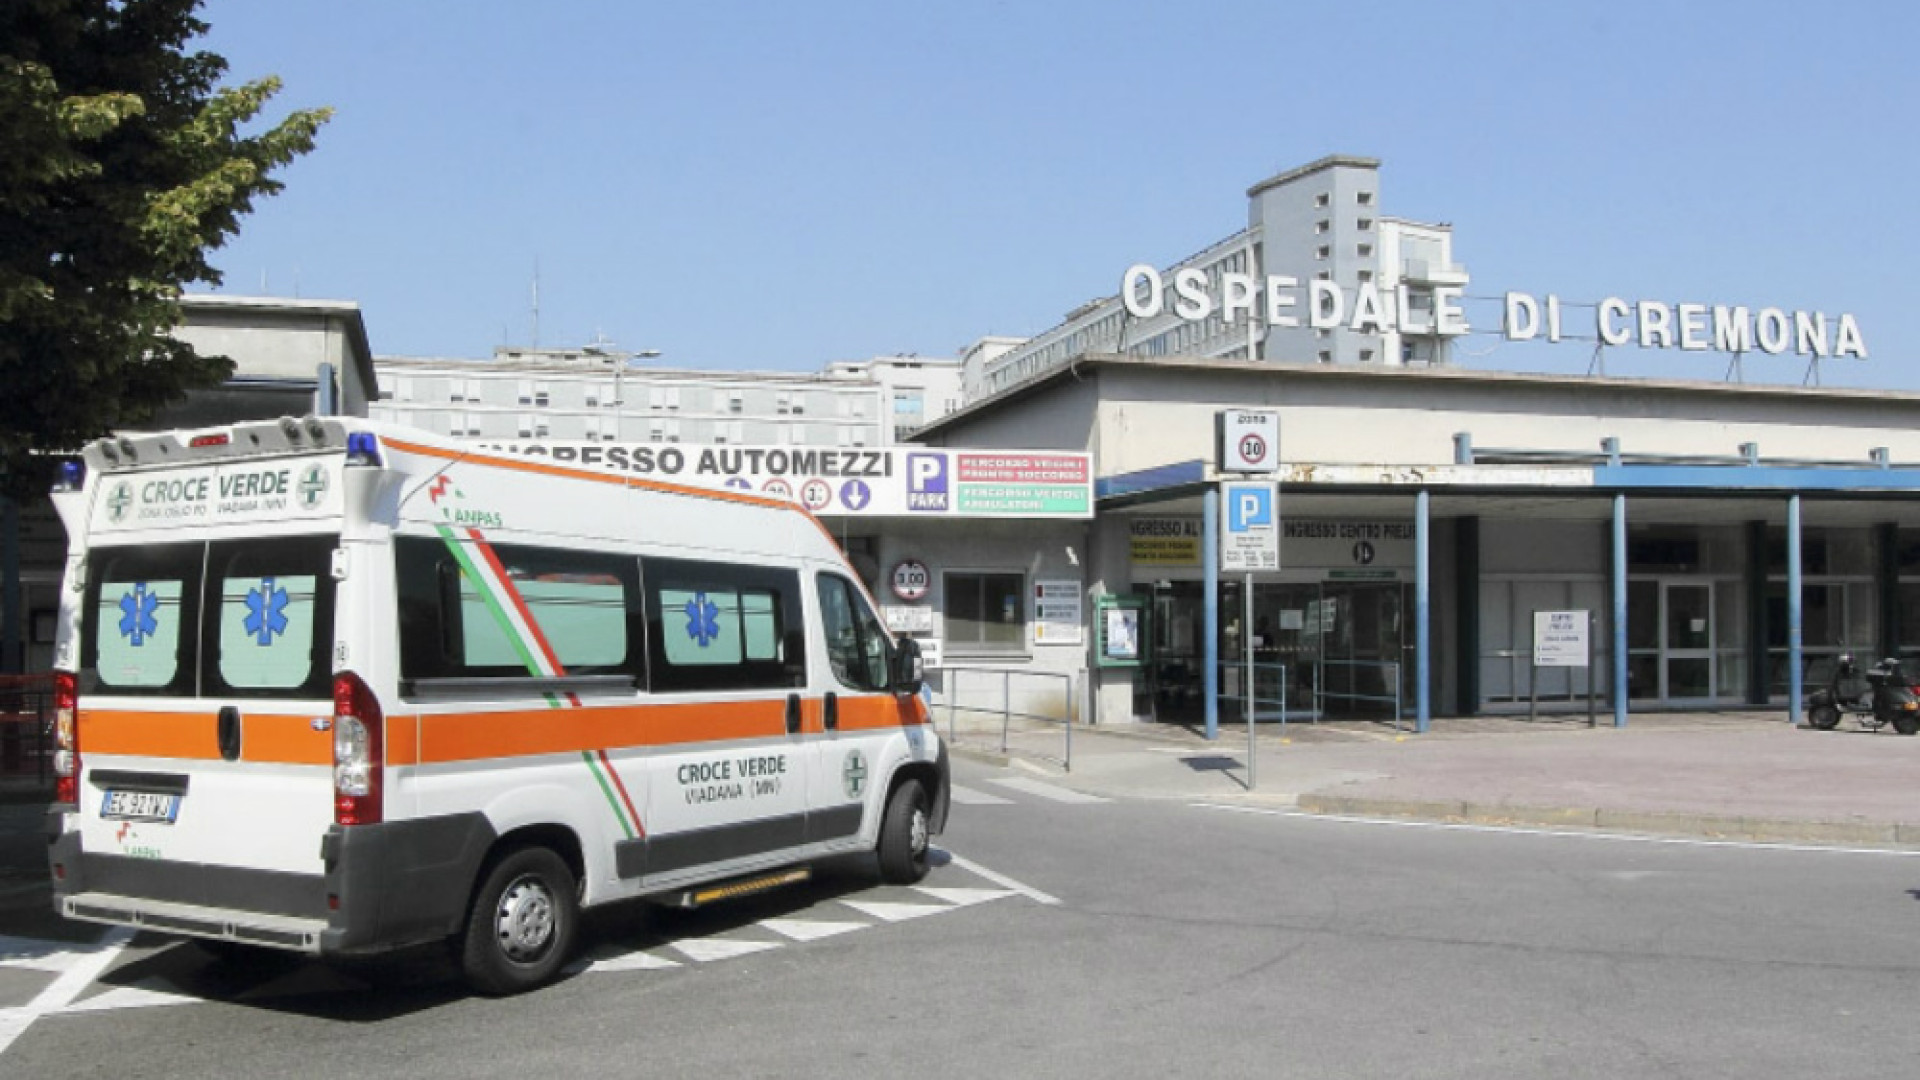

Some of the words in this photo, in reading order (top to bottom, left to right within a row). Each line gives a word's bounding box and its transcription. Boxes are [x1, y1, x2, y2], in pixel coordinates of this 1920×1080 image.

[1122, 264, 1470, 335] OSPEDALE
[1505, 291, 1560, 343] DI
[1597, 296, 1868, 360] CREMONA
[696, 448, 893, 477] AUTOMEZZI
[911, 455, 941, 492] P
[141, 476, 210, 504] CROCE
[219, 469, 290, 499] VERDE
[910, 492, 946, 509] PARK
[1239, 494, 1259, 526] P
[677, 759, 731, 785] CROCE
[737, 754, 786, 778] VERDE
